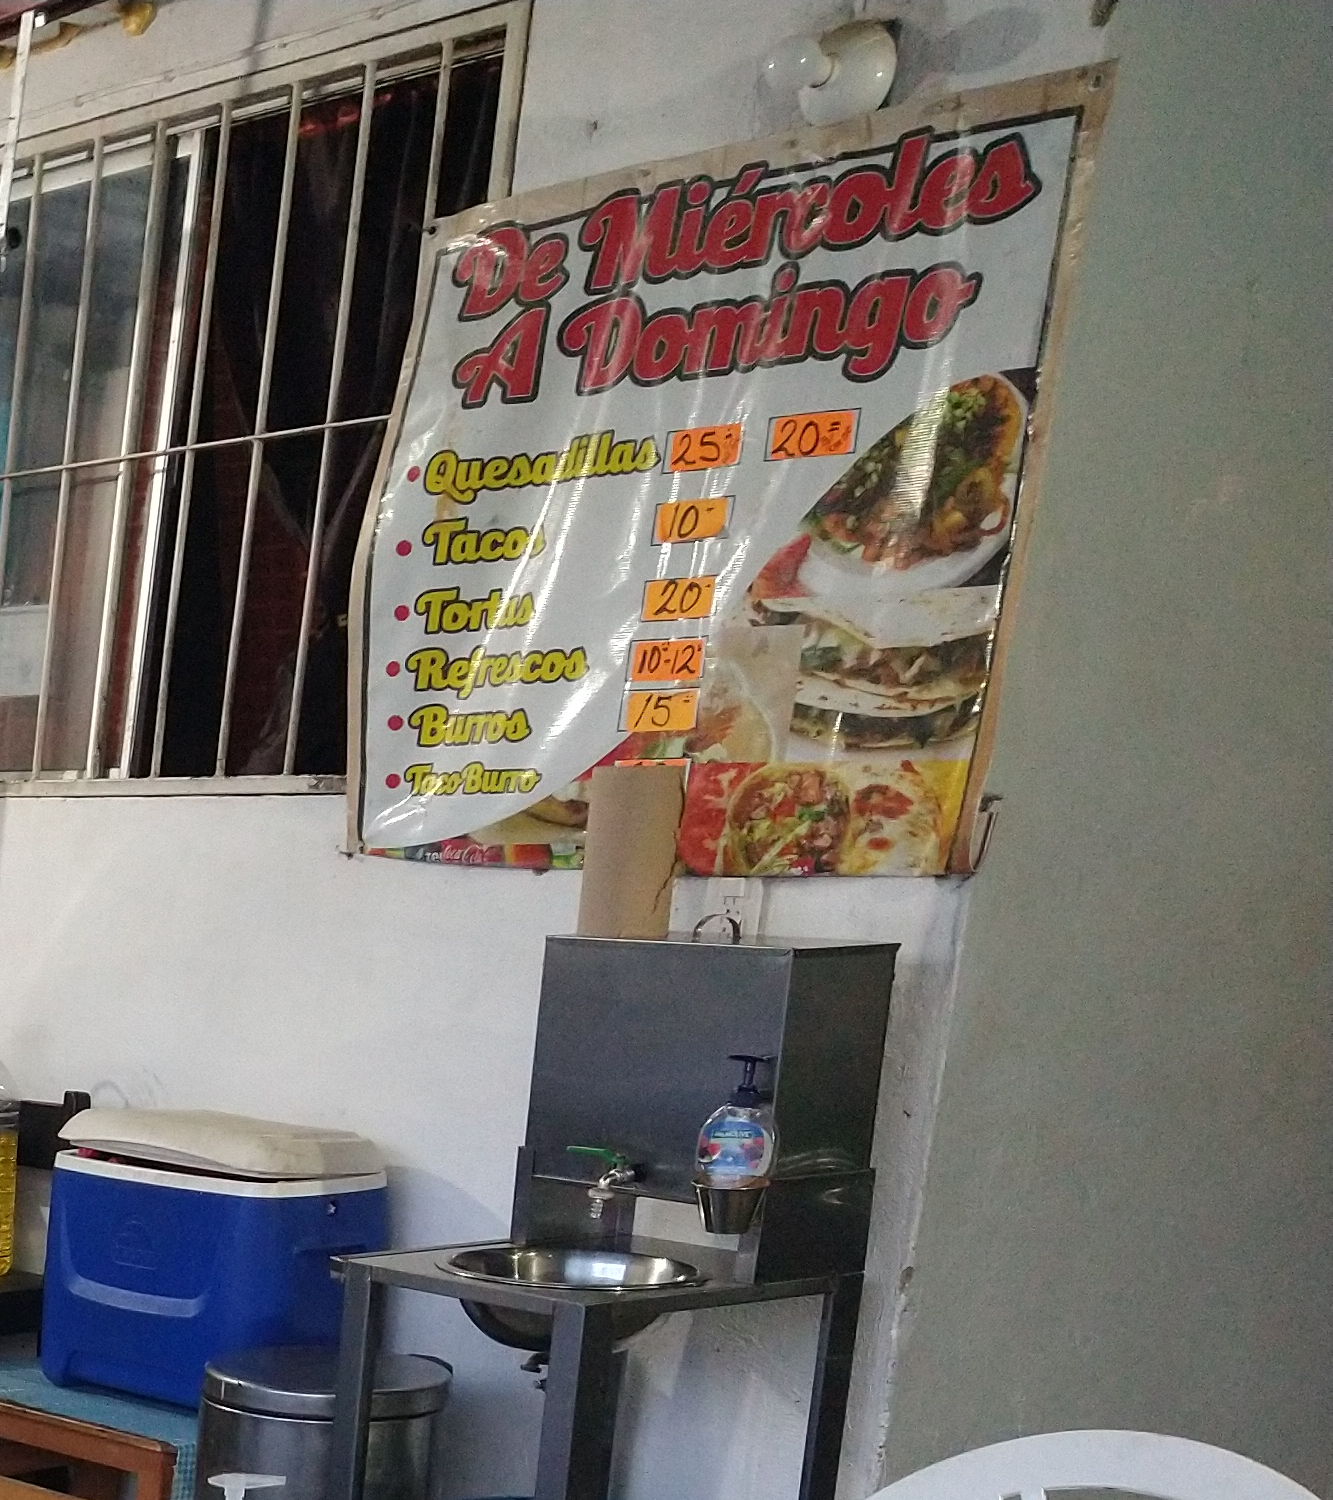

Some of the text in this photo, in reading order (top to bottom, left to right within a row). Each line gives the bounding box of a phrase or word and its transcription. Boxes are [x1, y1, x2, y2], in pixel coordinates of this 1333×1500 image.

[452, 127, 1041, 321] De Miércoles
[452, 261, 982, 409] A Domingo
[424, 429, 661, 503] Quesadillas
[422, 516, 546, 565] Tacos
[405, 645, 590, 700] Refrescos
[408, 703, 532, 747] Burros
